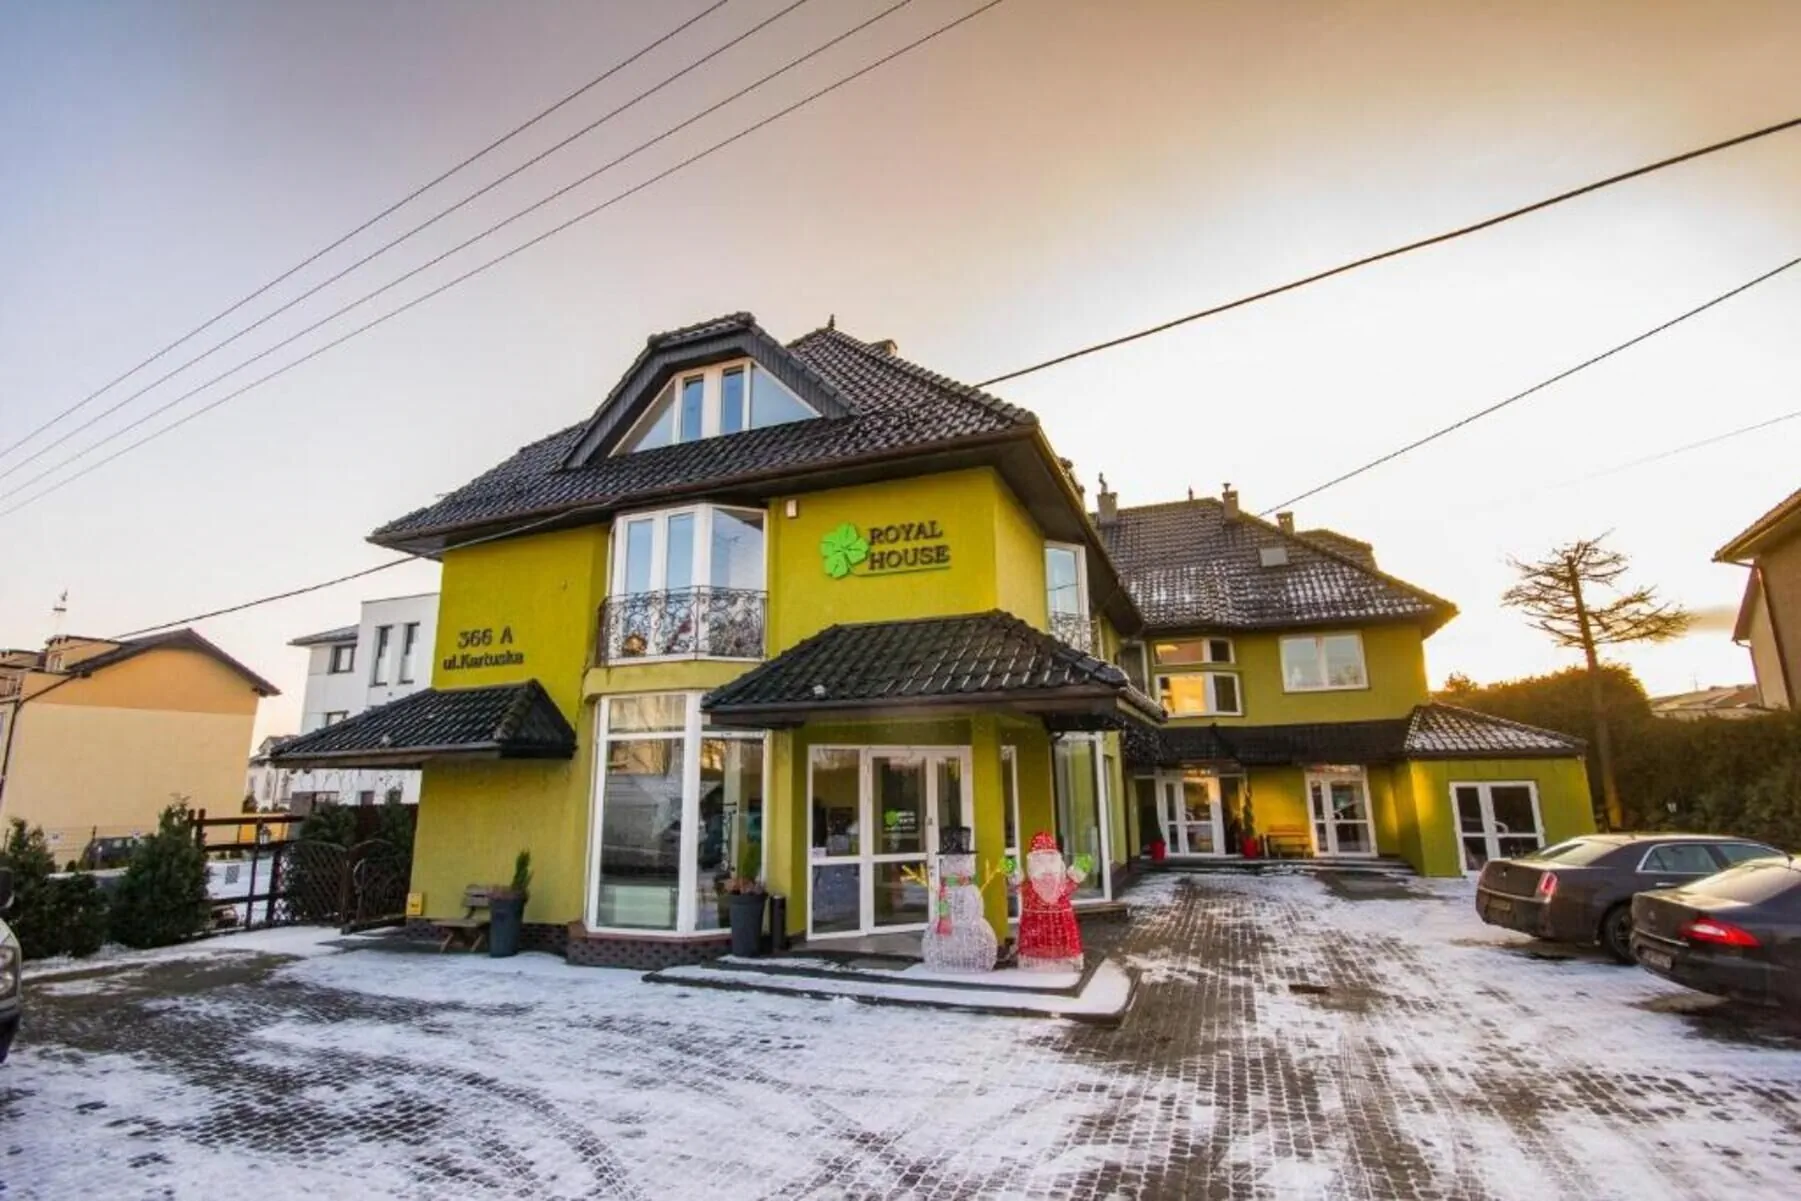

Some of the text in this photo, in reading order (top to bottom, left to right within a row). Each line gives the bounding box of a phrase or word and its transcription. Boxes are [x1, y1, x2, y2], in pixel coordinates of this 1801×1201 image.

[868, 520, 943, 545] ROYAL
[868, 545, 950, 570] HOUSE
[457, 626, 513, 649] 366 A
